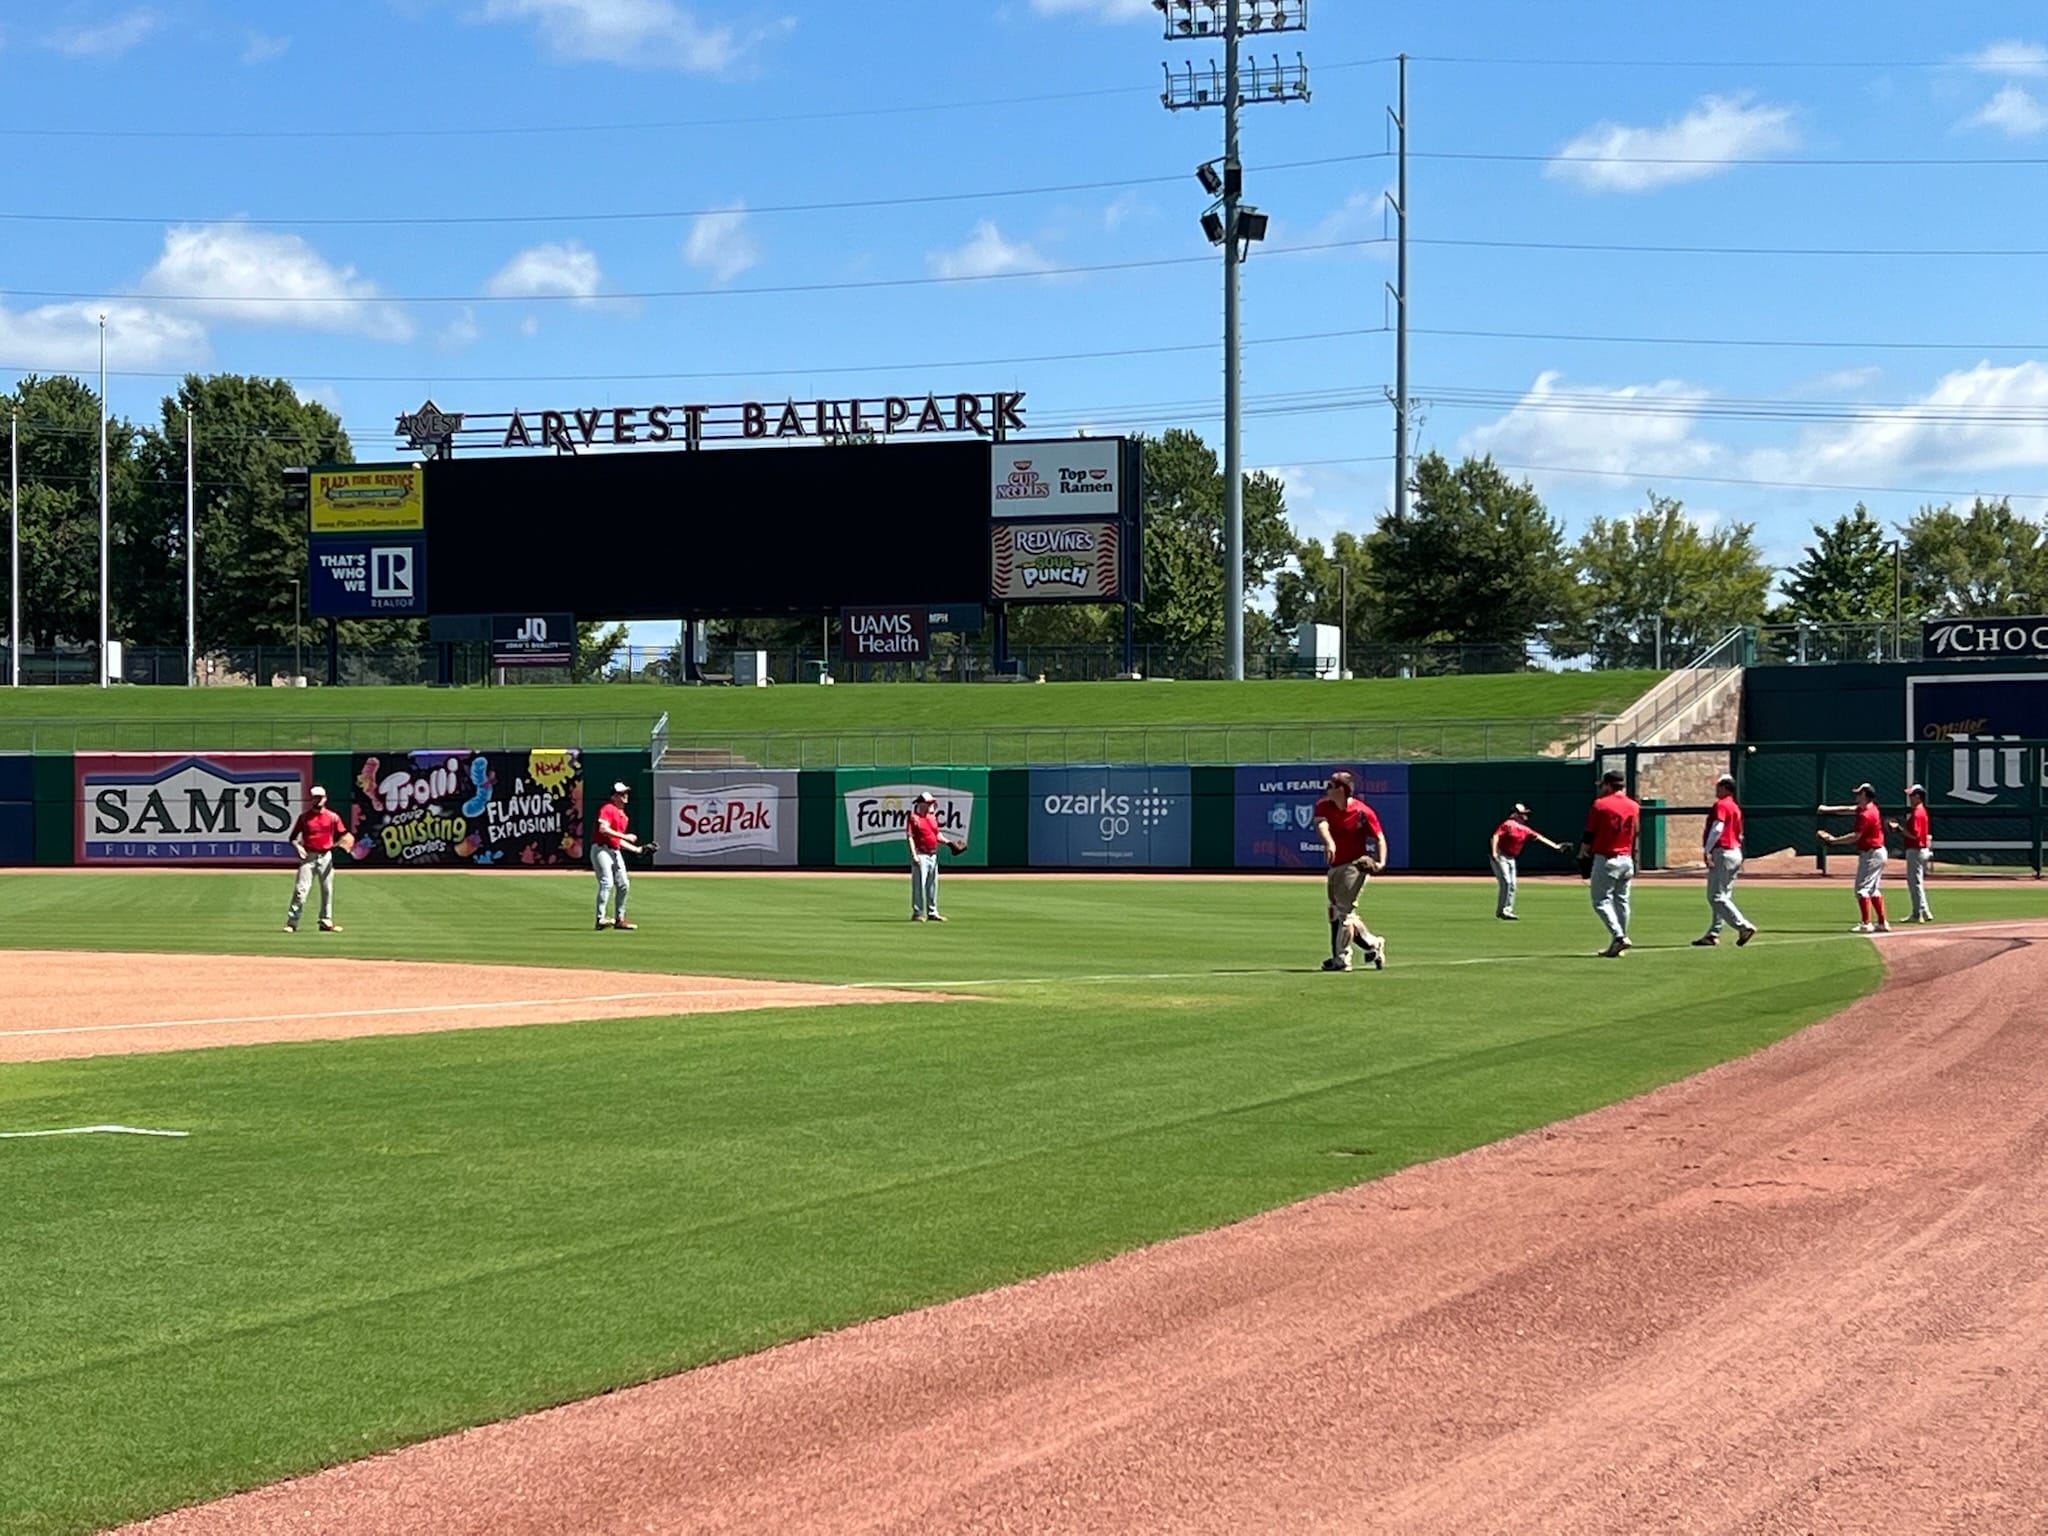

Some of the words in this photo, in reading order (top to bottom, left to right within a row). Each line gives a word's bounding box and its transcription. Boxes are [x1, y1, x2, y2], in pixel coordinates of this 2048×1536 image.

[395, 410, 464, 438] ARVEST
[501, 404, 709, 451] ARVEST
[742, 391, 1026, 438] BALLPARK
[320, 476, 349, 490] PLAZA
[374, 473, 415, 491] SERVICE
[1008, 471, 1039, 487] CUP
[1058, 468, 1087, 482] Top
[996, 483, 1049, 500] NOODLES
[1060, 482, 1113, 493] Ramen
[1016, 531, 1050, 554] RED
[1048, 528, 1094, 551] VINES
[320, 555, 366, 566] THAT'S
[1035, 556, 1073, 568] SOUR
[331, 568, 366, 579] WHO
[1021, 565, 1089, 588] PUNCH
[344, 581, 366, 592] WE
[371, 599, 413, 608] REALTOR
[850, 614, 912, 634] UAMS
[928, 613, 949, 624] MPH
[517, 617, 547, 642] JQ
[1950, 624, 2048, 651] CHOC
[859, 634, 919, 653] Health
[379, 758, 458, 812] Trolli
[514, 777, 525, 795] A
[1259, 782, 1283, 792] LIVE
[1286, 780, 1331, 790] FEARLE
[95, 786, 291, 834] SAM'S
[487, 792, 554, 824] FLAVOR
[1044, 788, 1130, 815] ozarks
[488, 812, 562, 843] EXPLOSION!
[677, 801, 772, 837] SeaPak
[1100, 816, 1129, 841] go
[381, 811, 466, 858] Bursting
[105, 842, 283, 856] FURNITURE
